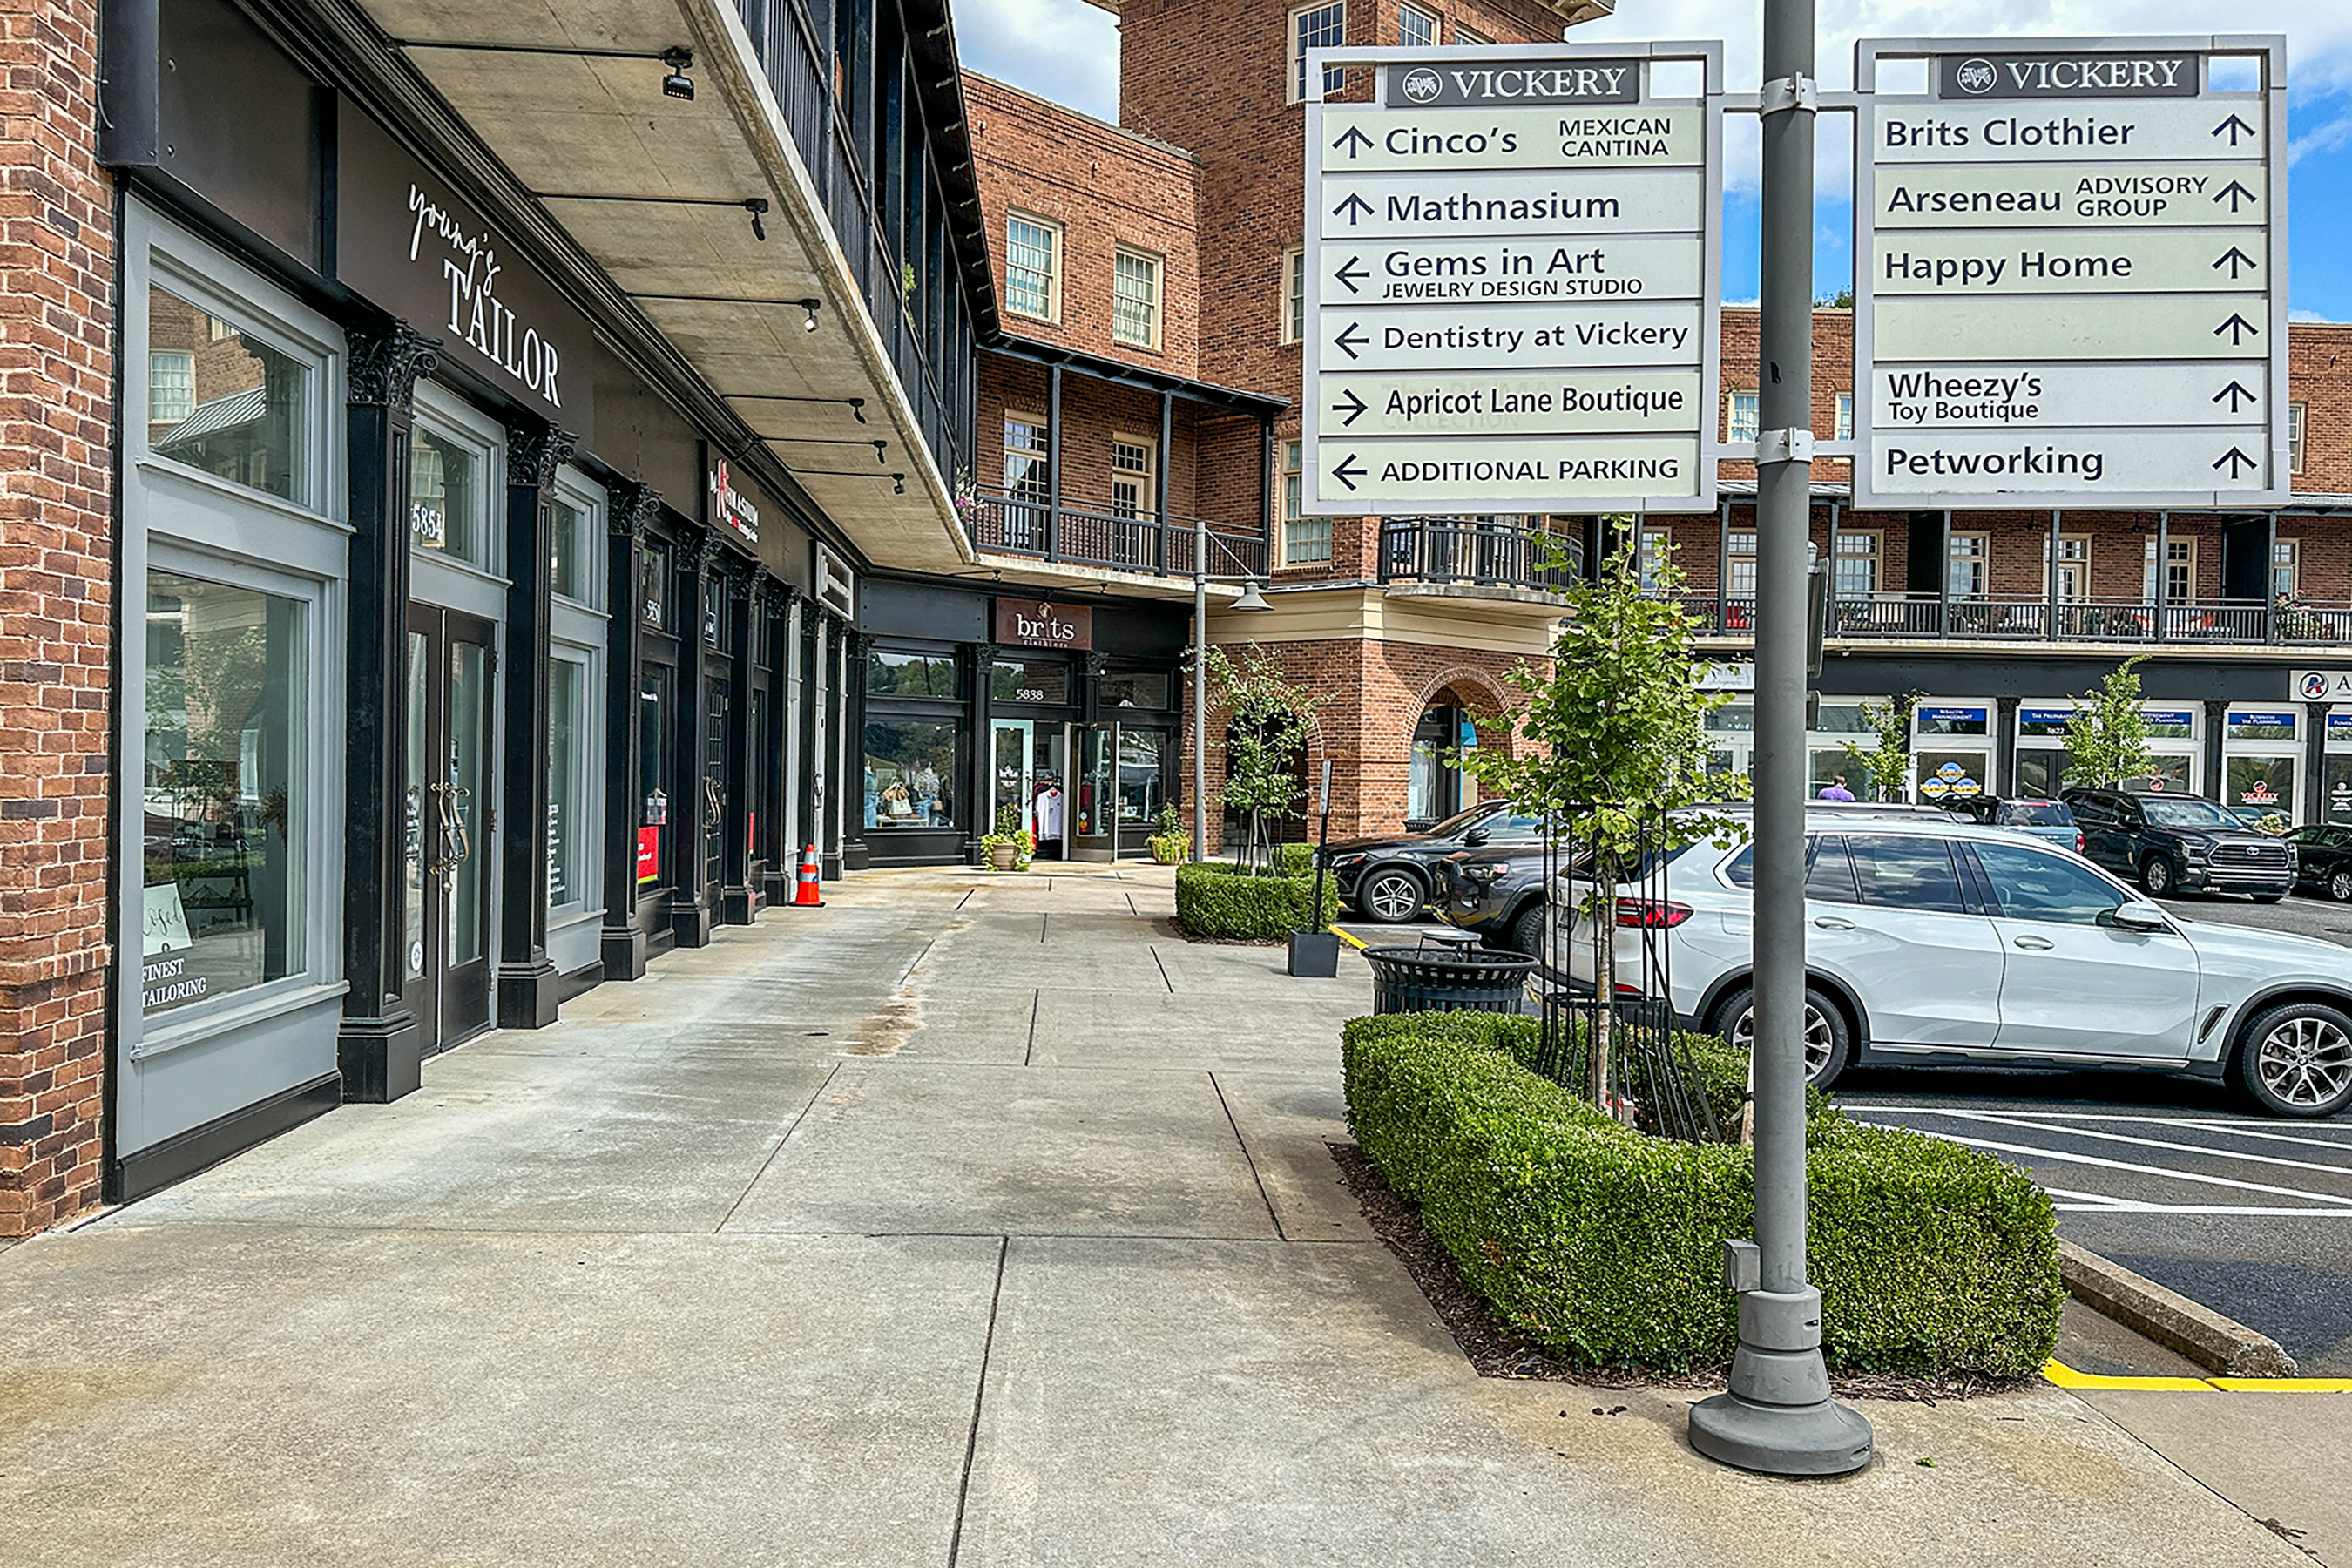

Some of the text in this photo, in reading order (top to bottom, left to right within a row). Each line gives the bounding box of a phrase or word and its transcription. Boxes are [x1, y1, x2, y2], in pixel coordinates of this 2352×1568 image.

[1451, 69, 1625, 98] VICKERY
[2006, 60, 2182, 88] VICKERY
[1386, 127, 1517, 154] Cinco's
[1559, 118, 1671, 137] MEXICAN
[1886, 118, 2135, 146] Brits Clothier
[1561, 139, 1669, 158] CANTINA
[1887, 186, 2061, 213] Arseneau
[2076, 177, 2208, 194] ADVISORY
[1388, 192, 1619, 221] Mathnasium
[2077, 199, 2167, 217] GROUP
[1385, 247, 1605, 276] Gems in Art
[1886, 252, 2132, 286] Happy Home
[1382, 279, 1643, 299] JEWELRY DESIGN STUDIO
[443, 258, 562, 409] TAILOR
[1384, 321, 1689, 353] Dentistry at Vickery
[1888, 371, 2042, 402] Wheezy's
[1385, 388, 1482, 422] Apricot
[1491, 388, 1552, 413] Lane
[1563, 384, 1683, 418] Boutique
[1888, 402, 2039, 424] Toy Boutique
[1381, 459, 1679, 482] ADDITIONAL PARKING
[1887, 446, 2103, 480] Petworking
[1016, 612, 1075, 640] brits
[1016, 688, 1044, 700] 5838
[142, 958, 184, 983] FINEST
[142, 977, 207, 1008] TAILORING
